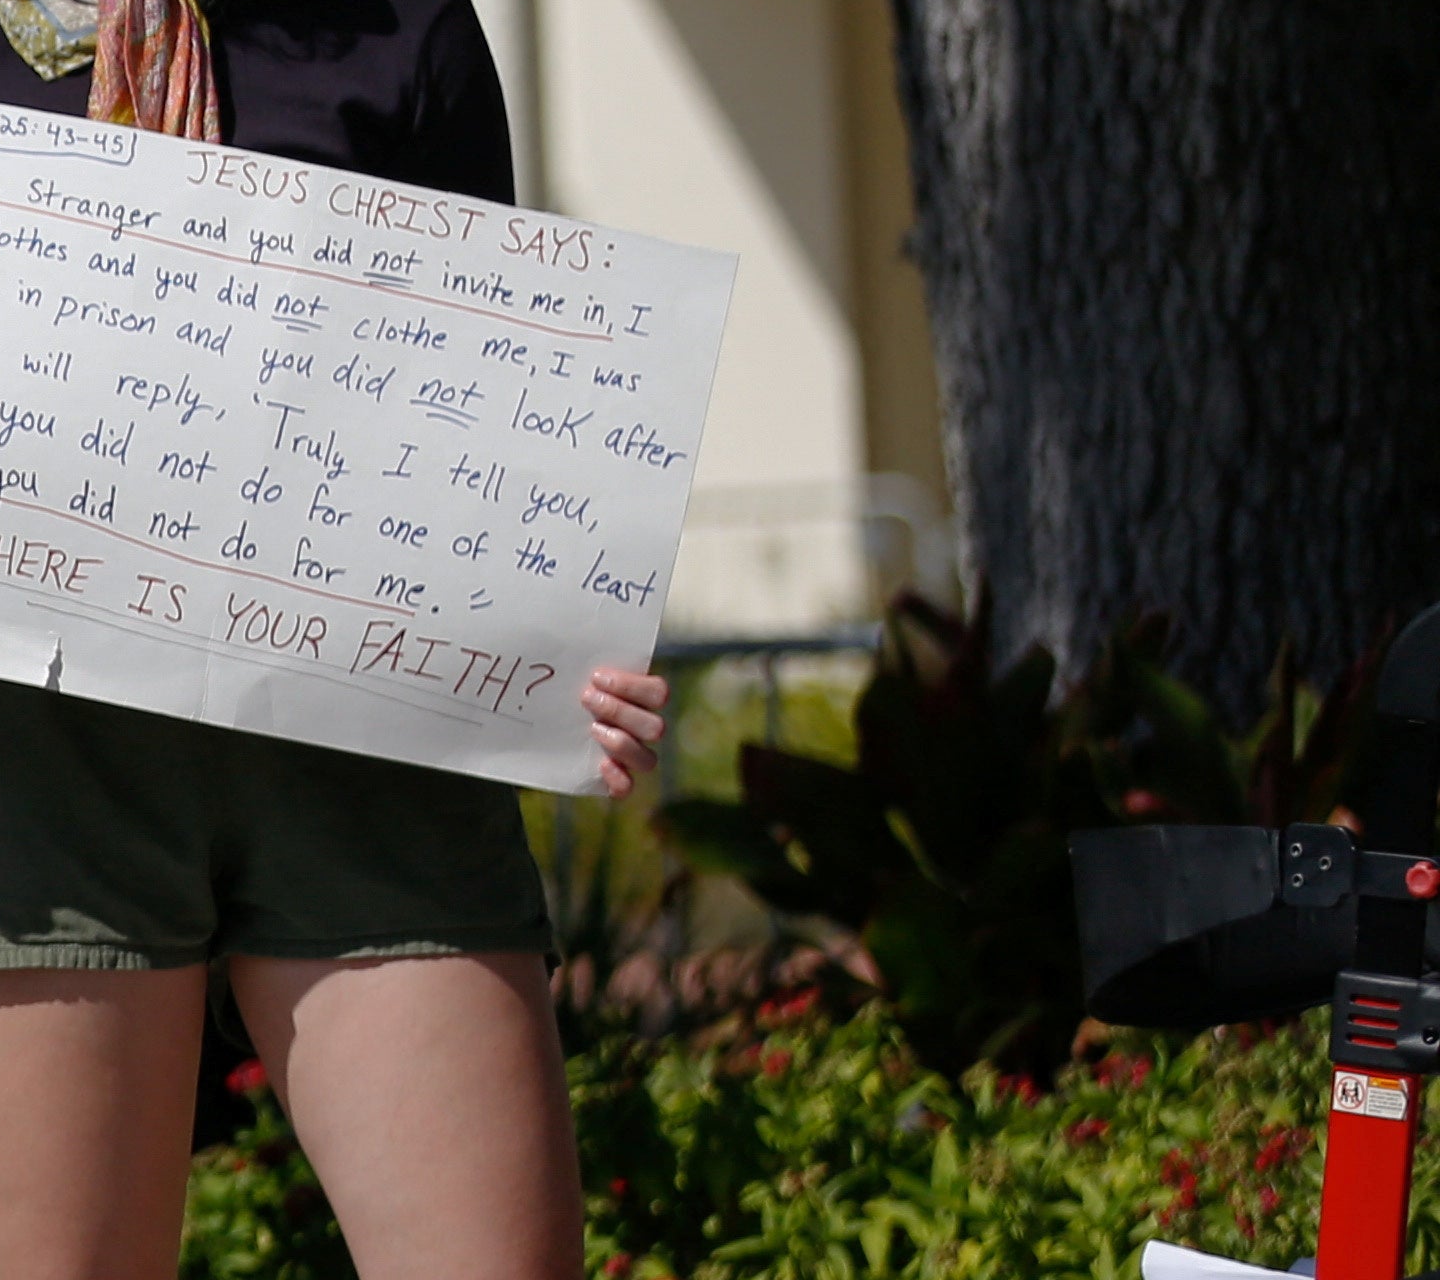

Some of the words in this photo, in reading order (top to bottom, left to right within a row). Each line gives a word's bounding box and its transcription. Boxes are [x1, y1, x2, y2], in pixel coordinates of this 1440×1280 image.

[183, 217, 227, 242] and
[250, 228, 294, 264] you
[313, 235, 352, 265] did
[370, 250, 423, 275] not
[442, 261, 514, 305] invite
[530, 292, 566, 315] me
[623, 305, 652, 336] I
[187, 150, 310, 204] JESUS
[329, 183, 486, 241] CHRIST
[500, 218, 615, 271] SAYS:
[18, 279, 42, 308] in
[53, 296, 156, 334] prison
[176, 321, 233, 358] and
[258, 347, 314, 384] you
[332, 353, 396, 403] did
[418, 378, 485, 409] not
[604, 422, 688, 469] after
[88, 253, 136, 277] and
[154, 266, 198, 300] you
[217, 275, 259, 312] did
[274, 293, 329, 318] not
[353, 316, 448, 350] clothe
[549, 350, 575, 378] I
[593, 366, 642, 393] was
[23, 351, 72, 382] will
[381, 442, 419, 478] I
[449, 453, 506, 503] tell
[69, 479, 117, 524] did
[148, 510, 201, 542] not
[220, 520, 257, 561] do
[291, 535, 347, 586] for
[80, 418, 135, 466] did
[158, 450, 218, 484] not
[240, 466, 283, 504] do
[308, 482, 353, 526] for
[379, 515, 428, 548] one
[452, 531, 489, 561] of
[515, 537, 557, 577] the
[581, 548, 656, 608] least
[127, 573, 188, 622] IS
[224, 592, 328, 659] YOUR
[350, 620, 556, 713] FAITH?
